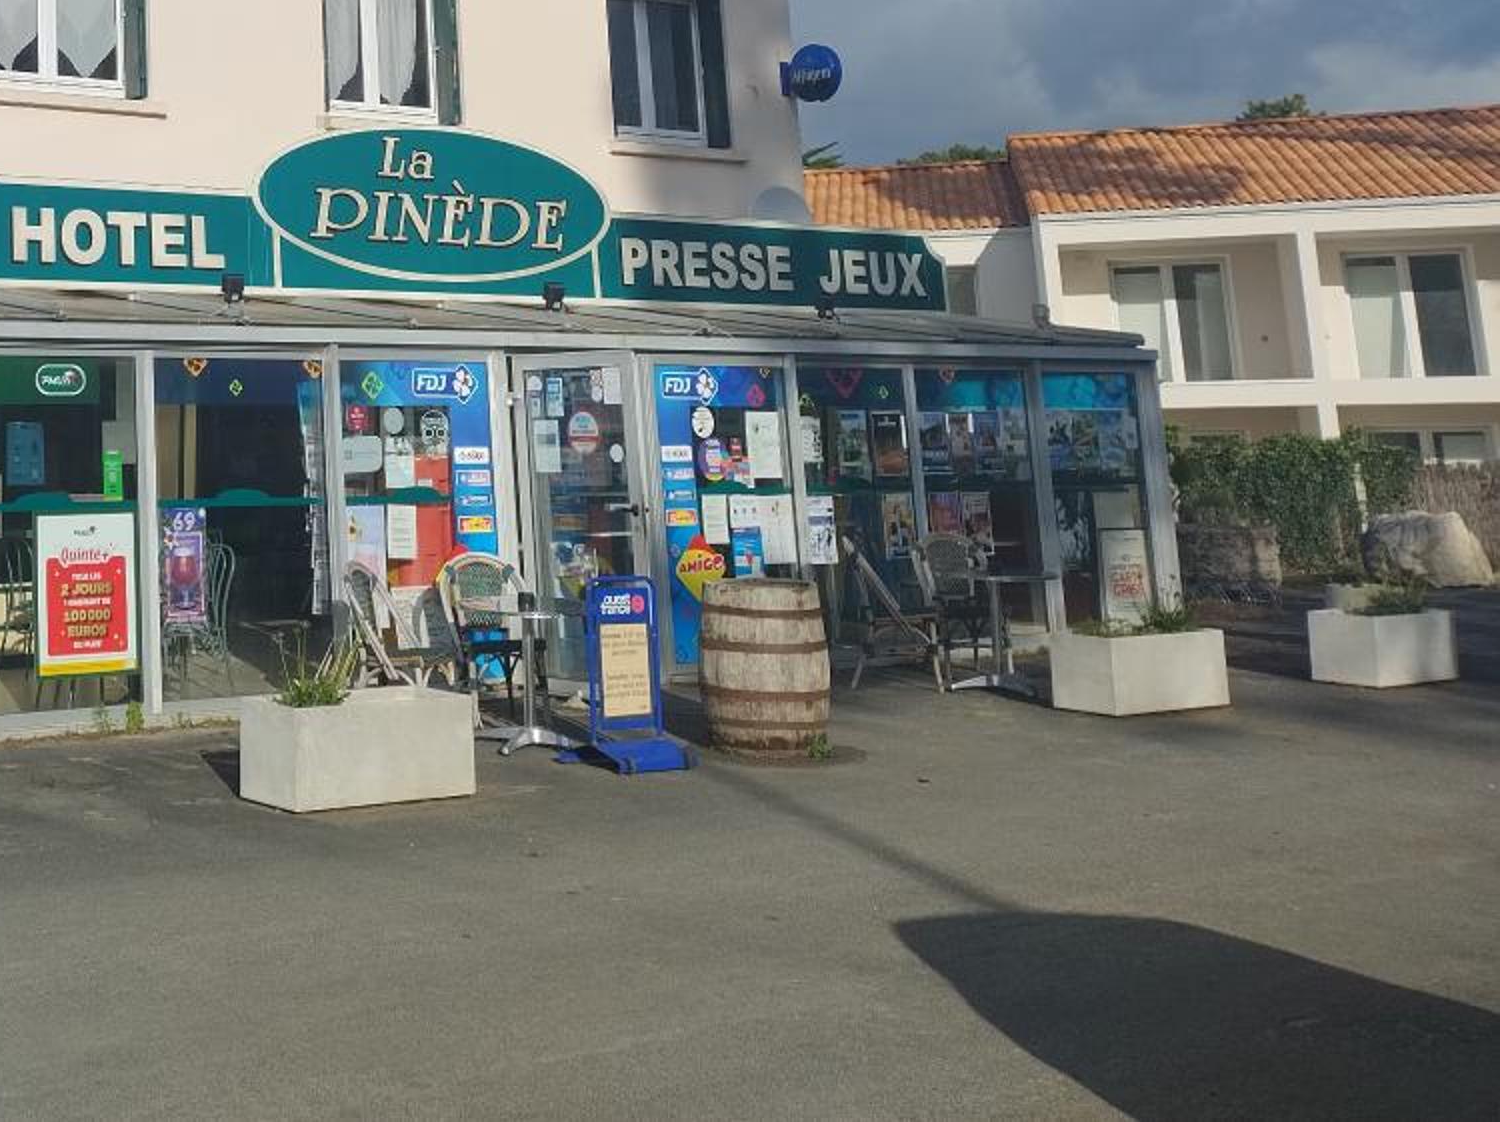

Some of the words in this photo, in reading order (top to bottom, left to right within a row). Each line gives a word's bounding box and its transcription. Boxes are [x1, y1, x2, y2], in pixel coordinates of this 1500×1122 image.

[378, 135, 435, 181] La
[308, 179, 568, 253] PINÈDE
[10, 206, 227, 270] HOTEL
[620, 236, 796, 292] PRESSE
[819, 249, 929, 297] JEUX
[416, 373, 447, 391] FDJ
[664, 377, 691, 393] FDJ
[173, 512, 196, 531] 69
[61, 583, 69, 597] 2
